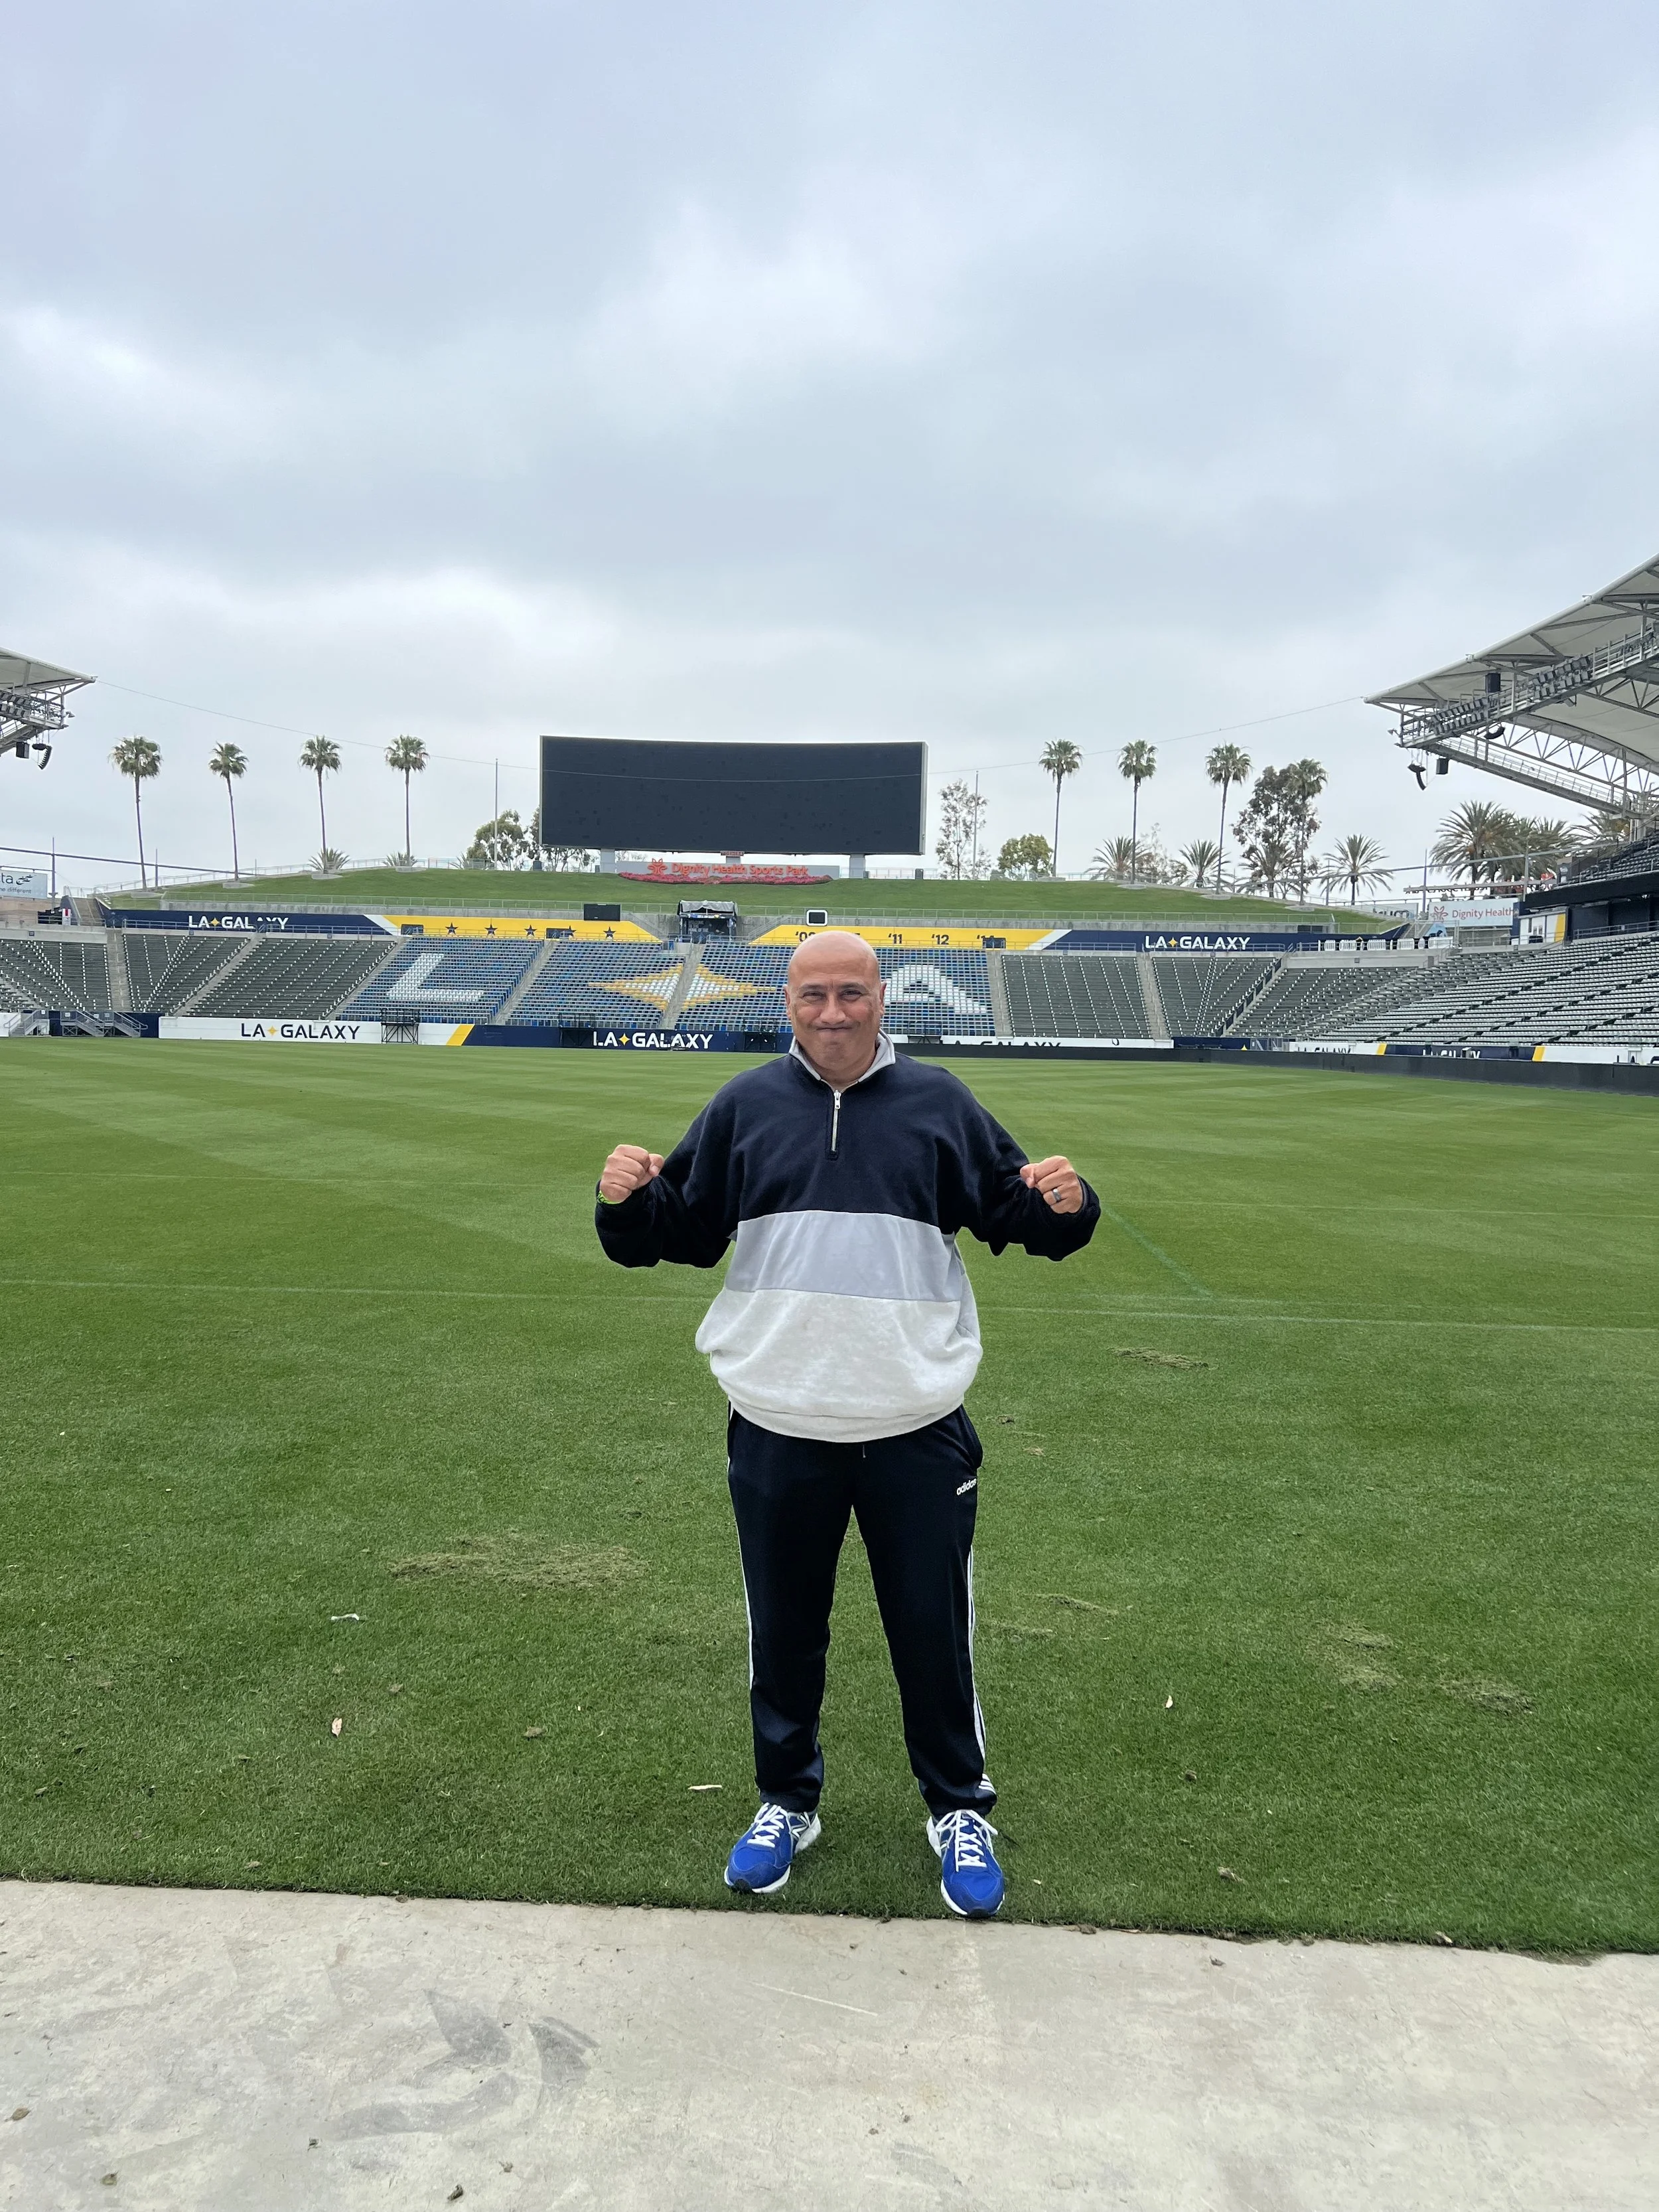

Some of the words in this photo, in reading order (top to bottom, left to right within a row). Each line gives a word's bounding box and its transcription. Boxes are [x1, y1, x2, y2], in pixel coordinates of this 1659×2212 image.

[671, 863, 710, 877] Dignity
[711, 864, 747, 873] Health
[749, 865, 783, 875] Sports
[786, 865, 808, 875] Park
[188, 915, 210, 928] LA
[1452, 909, 1483, 920] Dignity
[1145, 935, 1168, 949] LA
[1180, 936, 1251, 950] GALAXY
[241, 1023, 266, 1038] LA
[281, 1024, 360, 1040] GALAXY
[593, 1031, 618, 1047] LA
[632, 1032, 713, 1049] GALAXY
[956, 1478, 977, 1496] adidas
